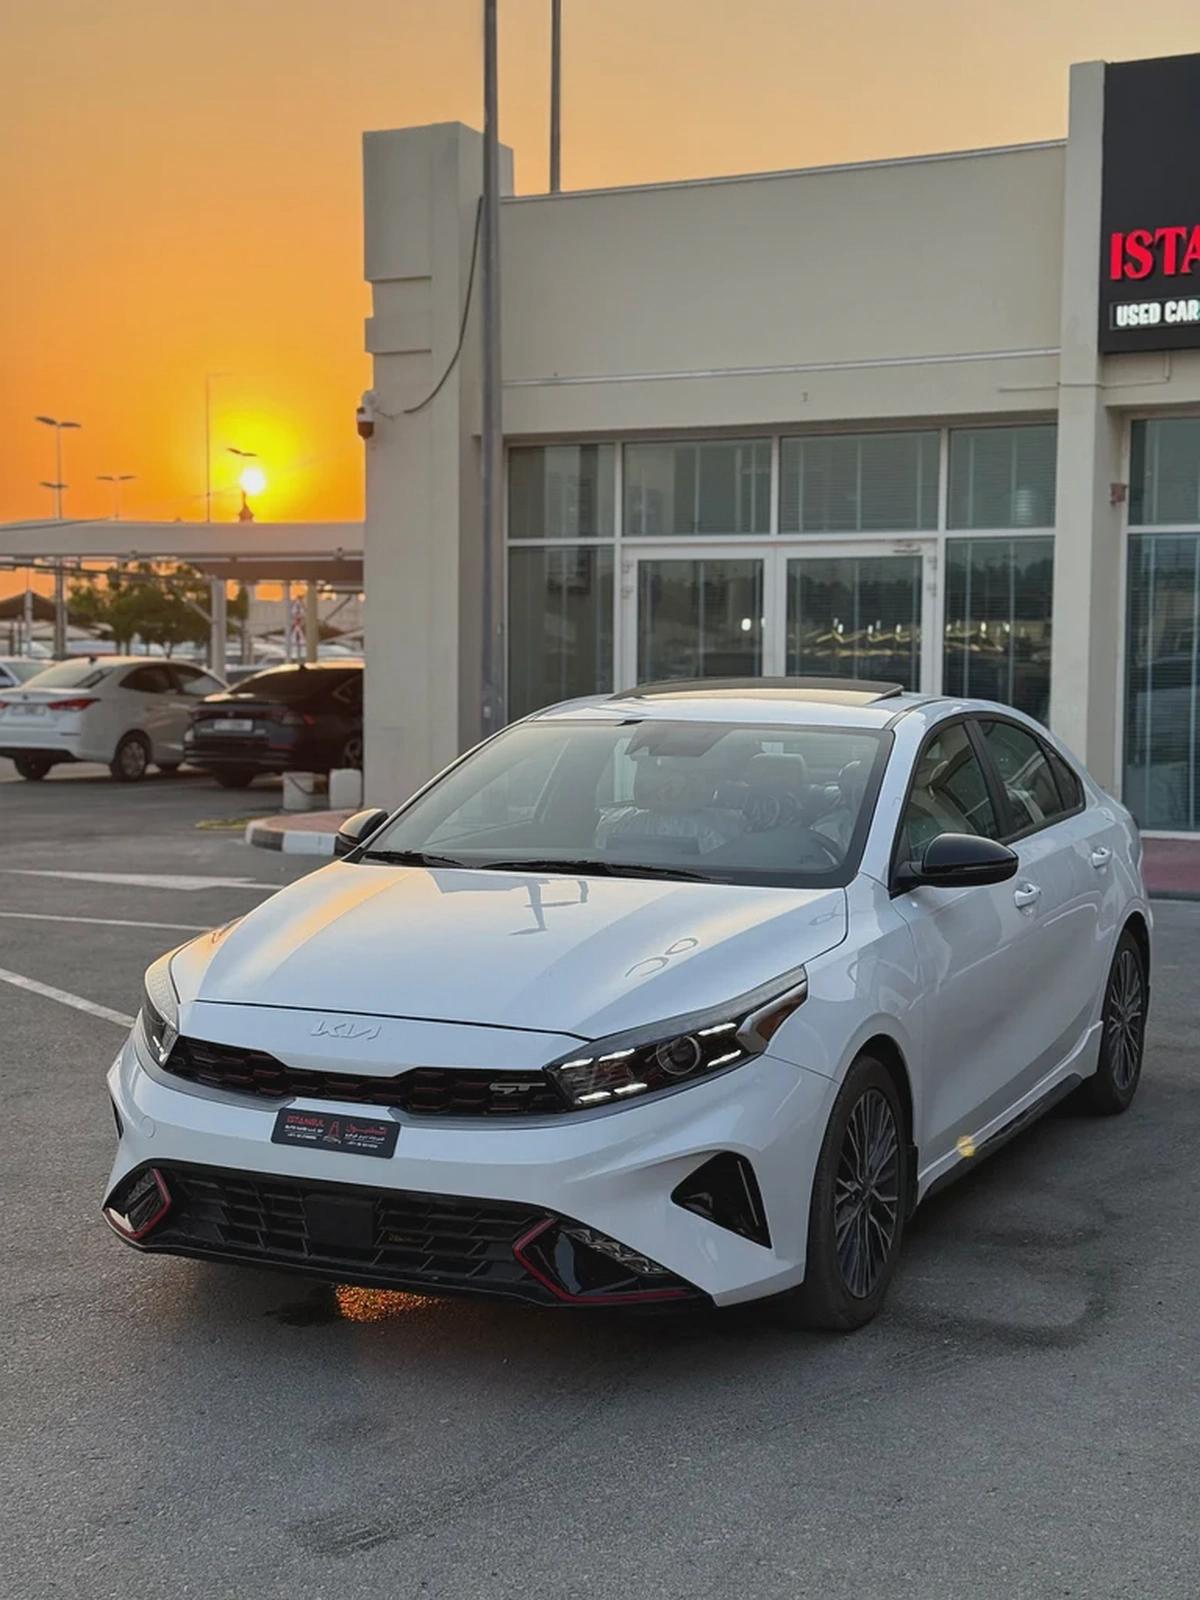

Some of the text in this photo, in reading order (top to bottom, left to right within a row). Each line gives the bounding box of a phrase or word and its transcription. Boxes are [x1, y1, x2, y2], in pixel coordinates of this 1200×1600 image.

[1116, 302, 1161, 327] USED
[310, 1021, 383, 1040] KIA
[489, 1082, 547, 1095] GT
